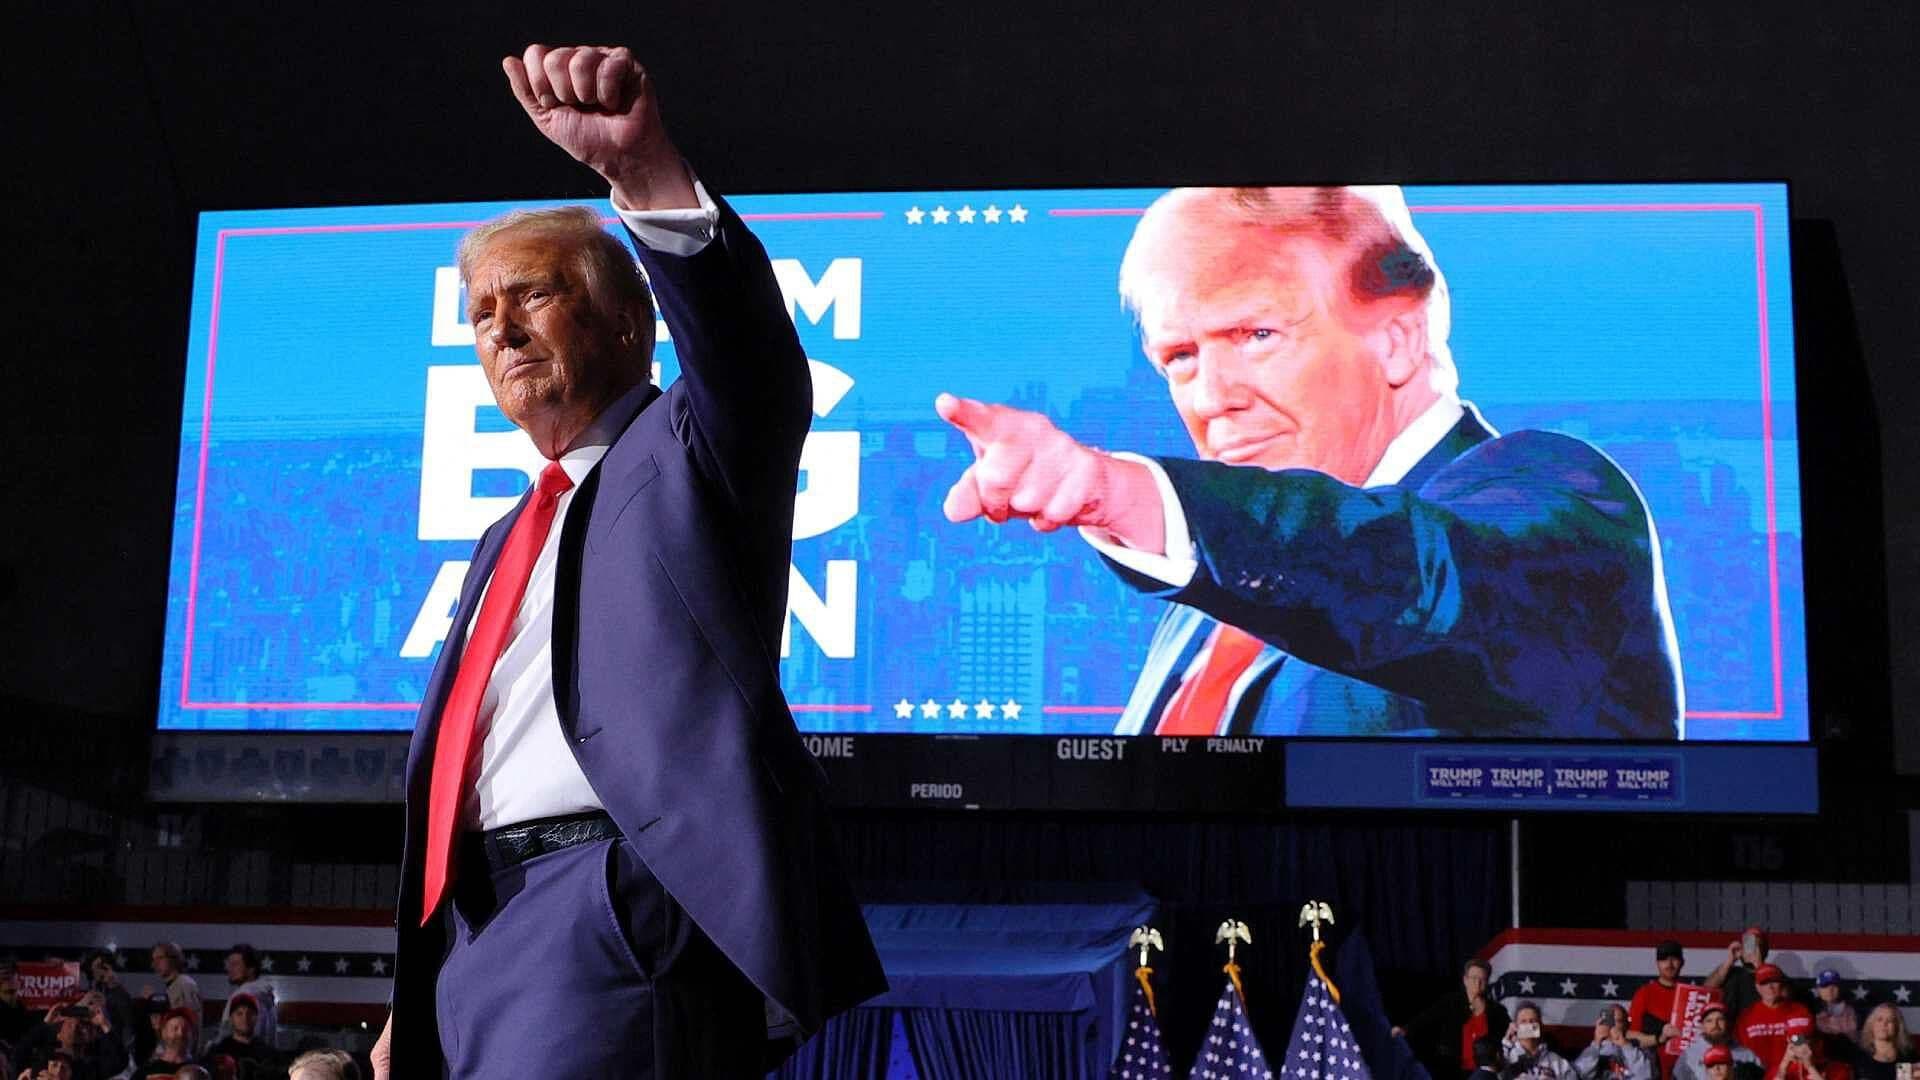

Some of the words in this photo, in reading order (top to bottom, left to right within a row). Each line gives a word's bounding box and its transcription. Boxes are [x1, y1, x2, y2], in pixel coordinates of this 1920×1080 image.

[417, 359, 861, 541] BG
[1056, 738, 1127, 760] GUEST
[1161, 738, 1189, 753] PLY
[1207, 738, 1265, 753] PENALTY
[1429, 767, 1482, 780] TRUMP
[1490, 768, 1544, 780] TRUMP
[1554, 768, 1608, 780] TRUMP
[1616, 769, 1669, 781] TRUMP
[911, 783, 963, 799] PERIOD
